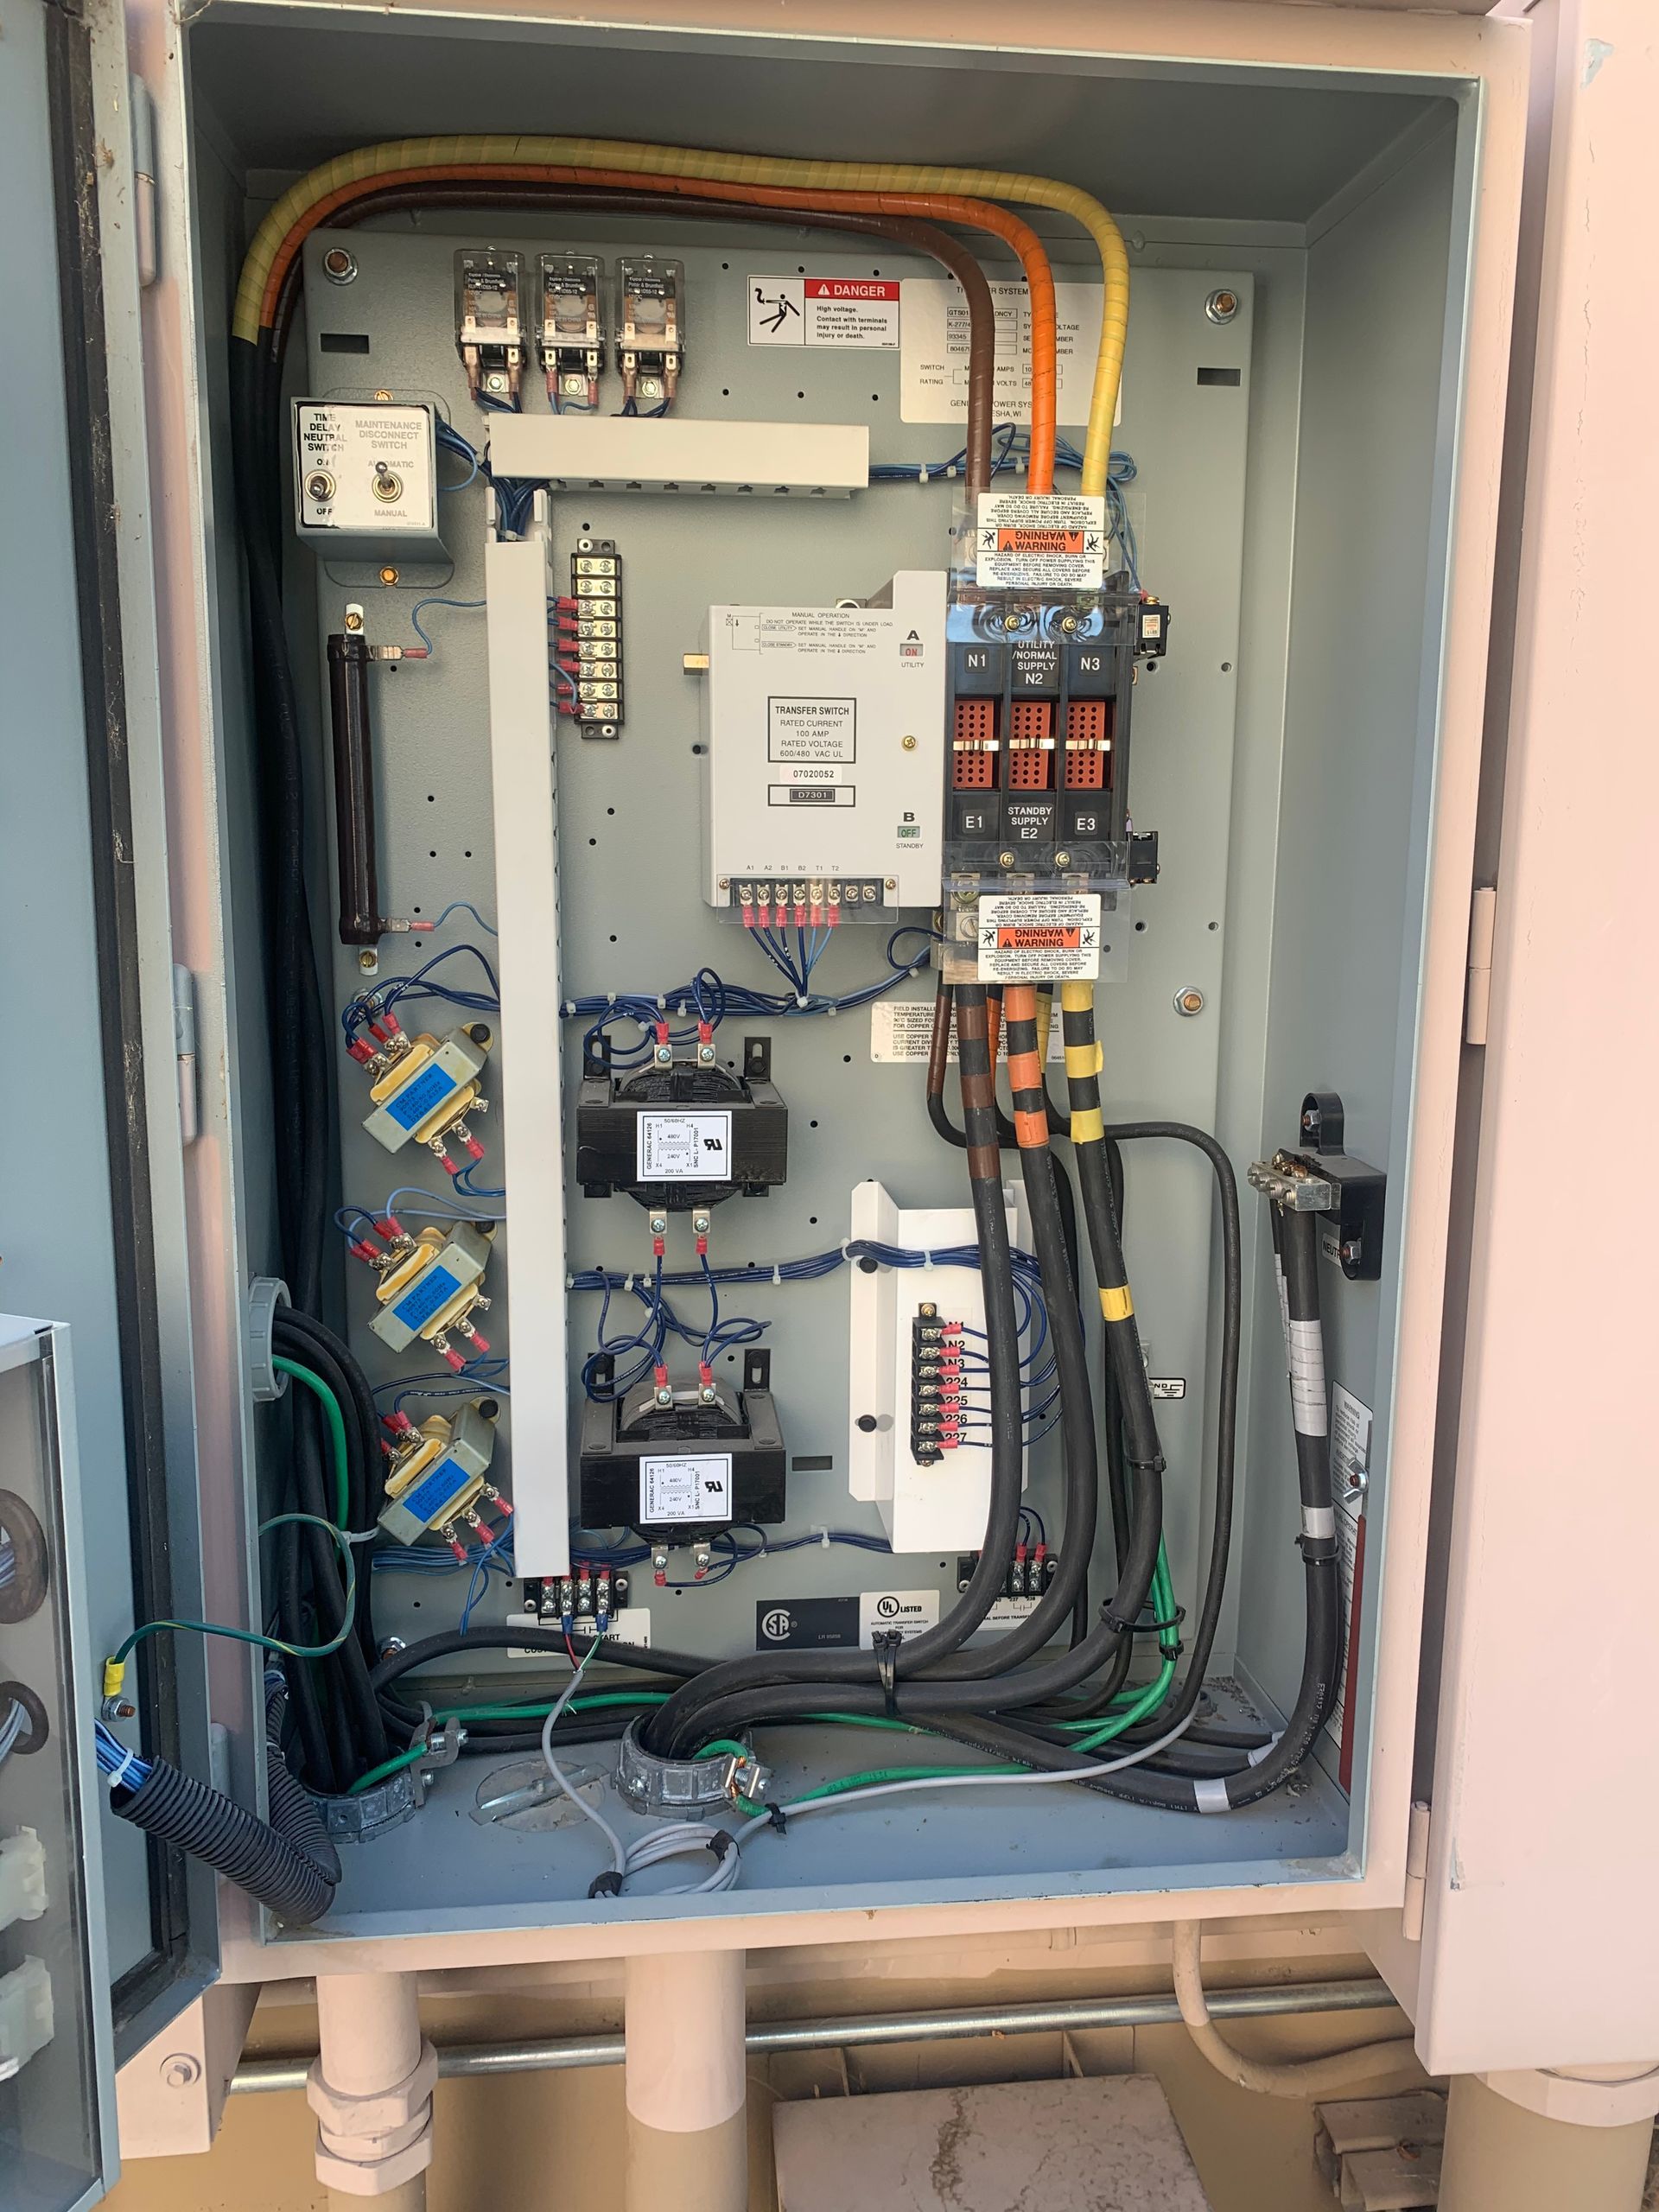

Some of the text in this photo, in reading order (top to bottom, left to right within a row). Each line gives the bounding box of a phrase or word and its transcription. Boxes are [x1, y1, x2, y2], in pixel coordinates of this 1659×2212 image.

[834, 285, 885, 296] DANGER
[310, 423, 340, 431] DELAY
[355, 420, 422, 430] MAINTENANCE
[304, 433, 347, 442] NEUTRAL
[359, 430, 419, 439] DISCONNECT
[371, 440, 407, 449] SWITCH
[1016, 531, 1066, 540] WARNING
[1015, 542, 1066, 551] WARNING
[907, 630, 920, 640] A
[1018, 640, 1055, 649] UTILITY
[1012, 651, 1057, 660] /NORMAL
[968, 655, 986, 667] N1
[1081, 658, 1100, 671] N3
[1017, 662, 1055, 671] SUPPLY
[1025, 673, 1043, 684] N2
[775, 706, 849, 715] TRANSFER SWITCH
[1008, 807, 1052, 815] STANDBY
[903, 812, 915, 822] B
[966, 816, 983, 828] E1
[1011, 817, 1048, 825] SUPPLY
[1077, 818, 1096, 830] E3
[901, 829, 917, 837] OFF
[1021, 828, 1038, 839] E2
[1323, 1240, 1340, 1260] NEUTR
[948, 1340, 965, 1351] N2
[948, 1359, 965, 1369] N3
[946, 1377, 968, 1387] 224
[946, 1396, 967, 1405] 225
[945, 1414, 967, 1424] 226
